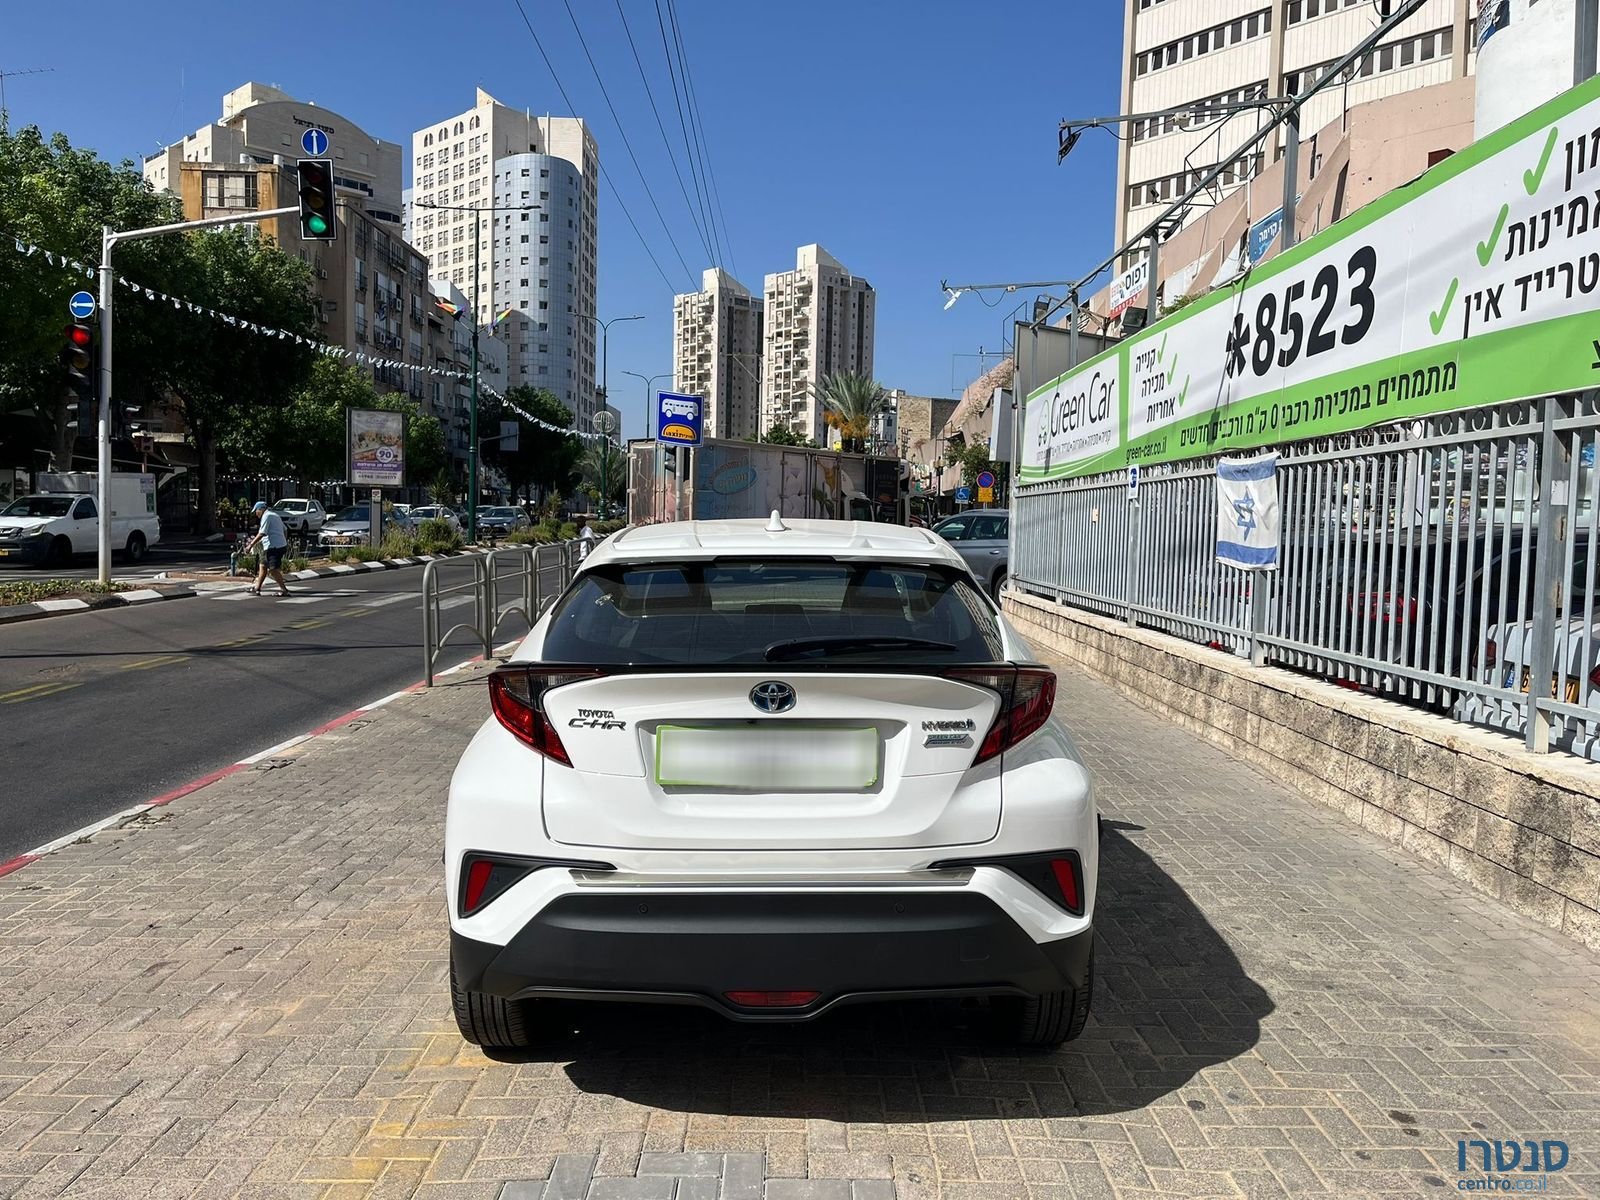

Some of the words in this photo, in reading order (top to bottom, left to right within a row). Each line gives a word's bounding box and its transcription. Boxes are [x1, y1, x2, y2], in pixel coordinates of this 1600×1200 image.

[1125, 262, 1147, 290] דפוס
[1515, 252, 1600, 312] טרייד
[1463, 283, 1504, 340] אין
[1135, 348, 1156, 373] קנייה
[1141, 372, 1165, 398] מכירה
[1377, 361, 1457, 406] מתמחים
[1051, 392, 1086, 437] Green
[1089, 371, 1115, 424] Car
[1146, 396, 1175, 423] אחריות
[1282, 400, 1309, 427] רכבי
[1312, 384, 1371, 420] במכירת
[1270, 404, 1278, 430] 0
[1180, 423, 1209, 447] חדשים
[378, 450, 392, 458] 90
[1126, 436, 1167, 463] green-car.co.il
[568, 718, 627, 731] C-HR
[577, 708, 615, 719] TOYOTA
